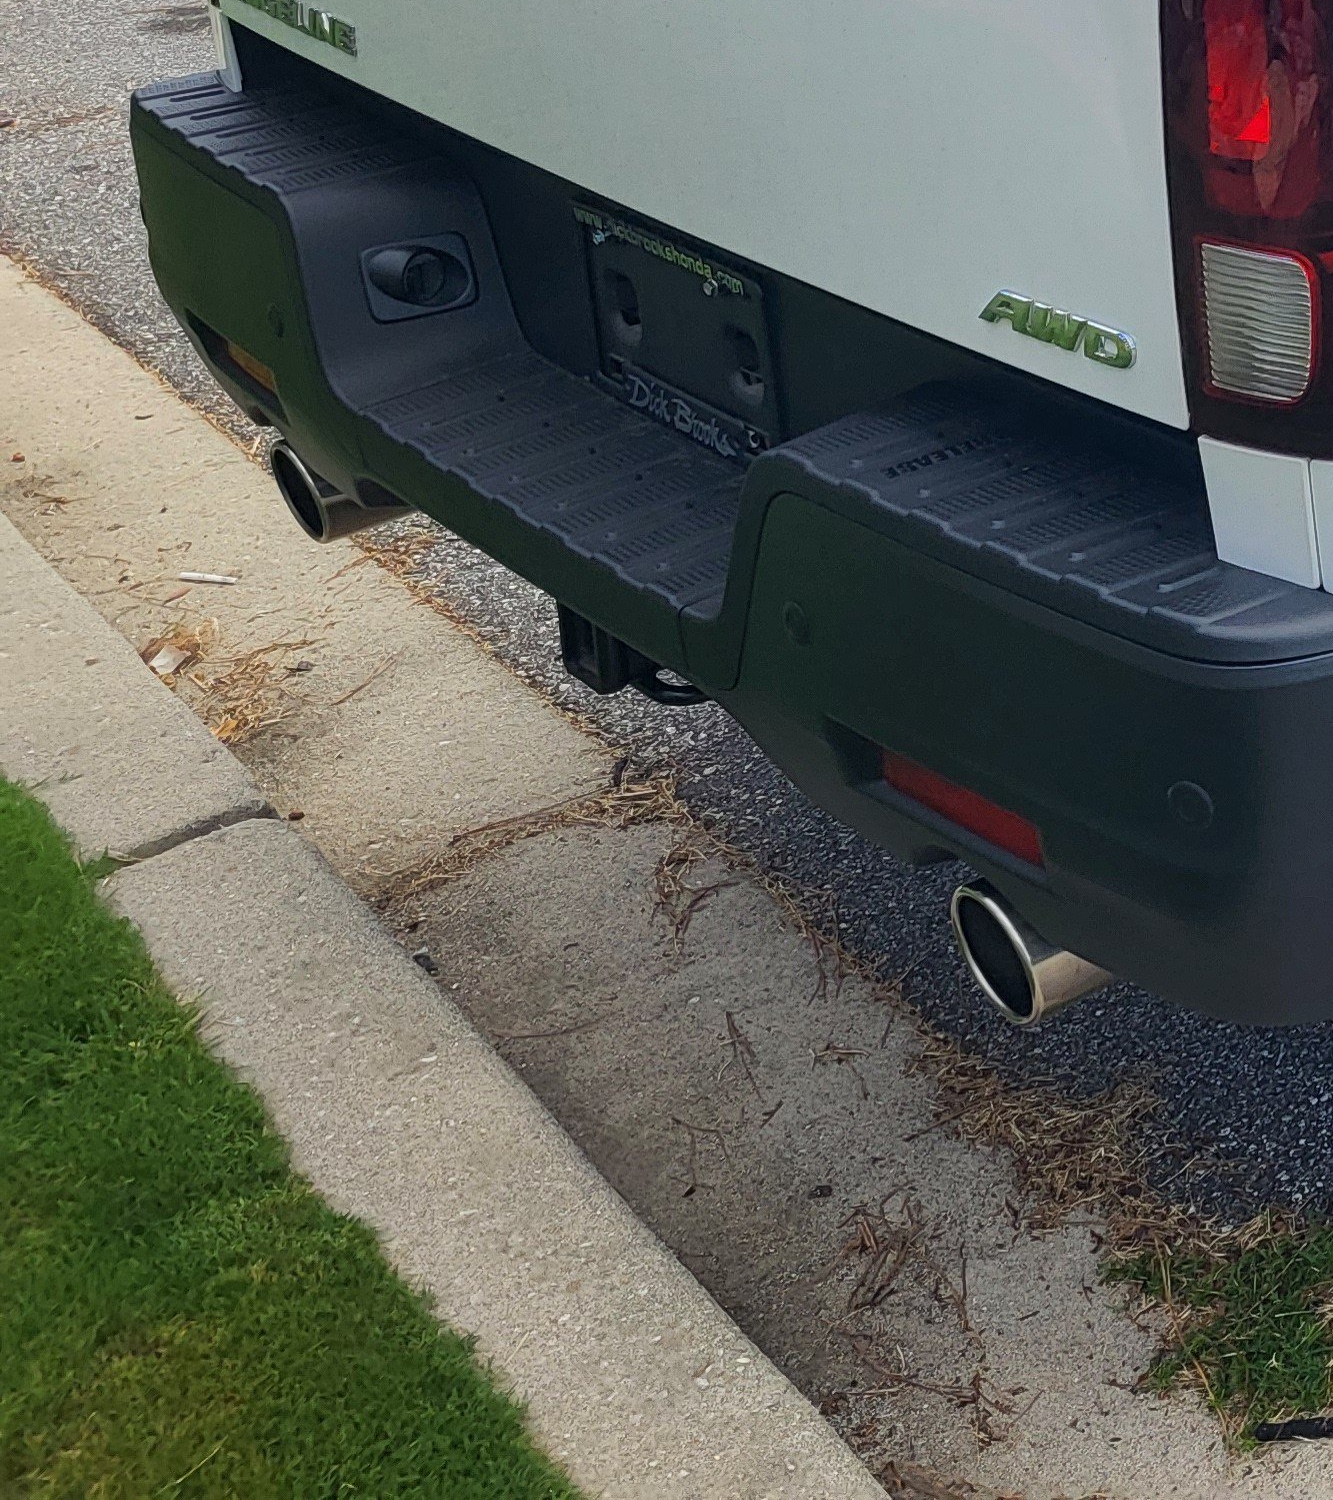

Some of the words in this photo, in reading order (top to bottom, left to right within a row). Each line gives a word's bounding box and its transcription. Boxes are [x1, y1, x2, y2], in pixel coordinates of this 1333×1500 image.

[978, 289, 1137, 369] AWD
[627, 373, 670, 422] Dick
[671, 398, 737, 457] Brooks
